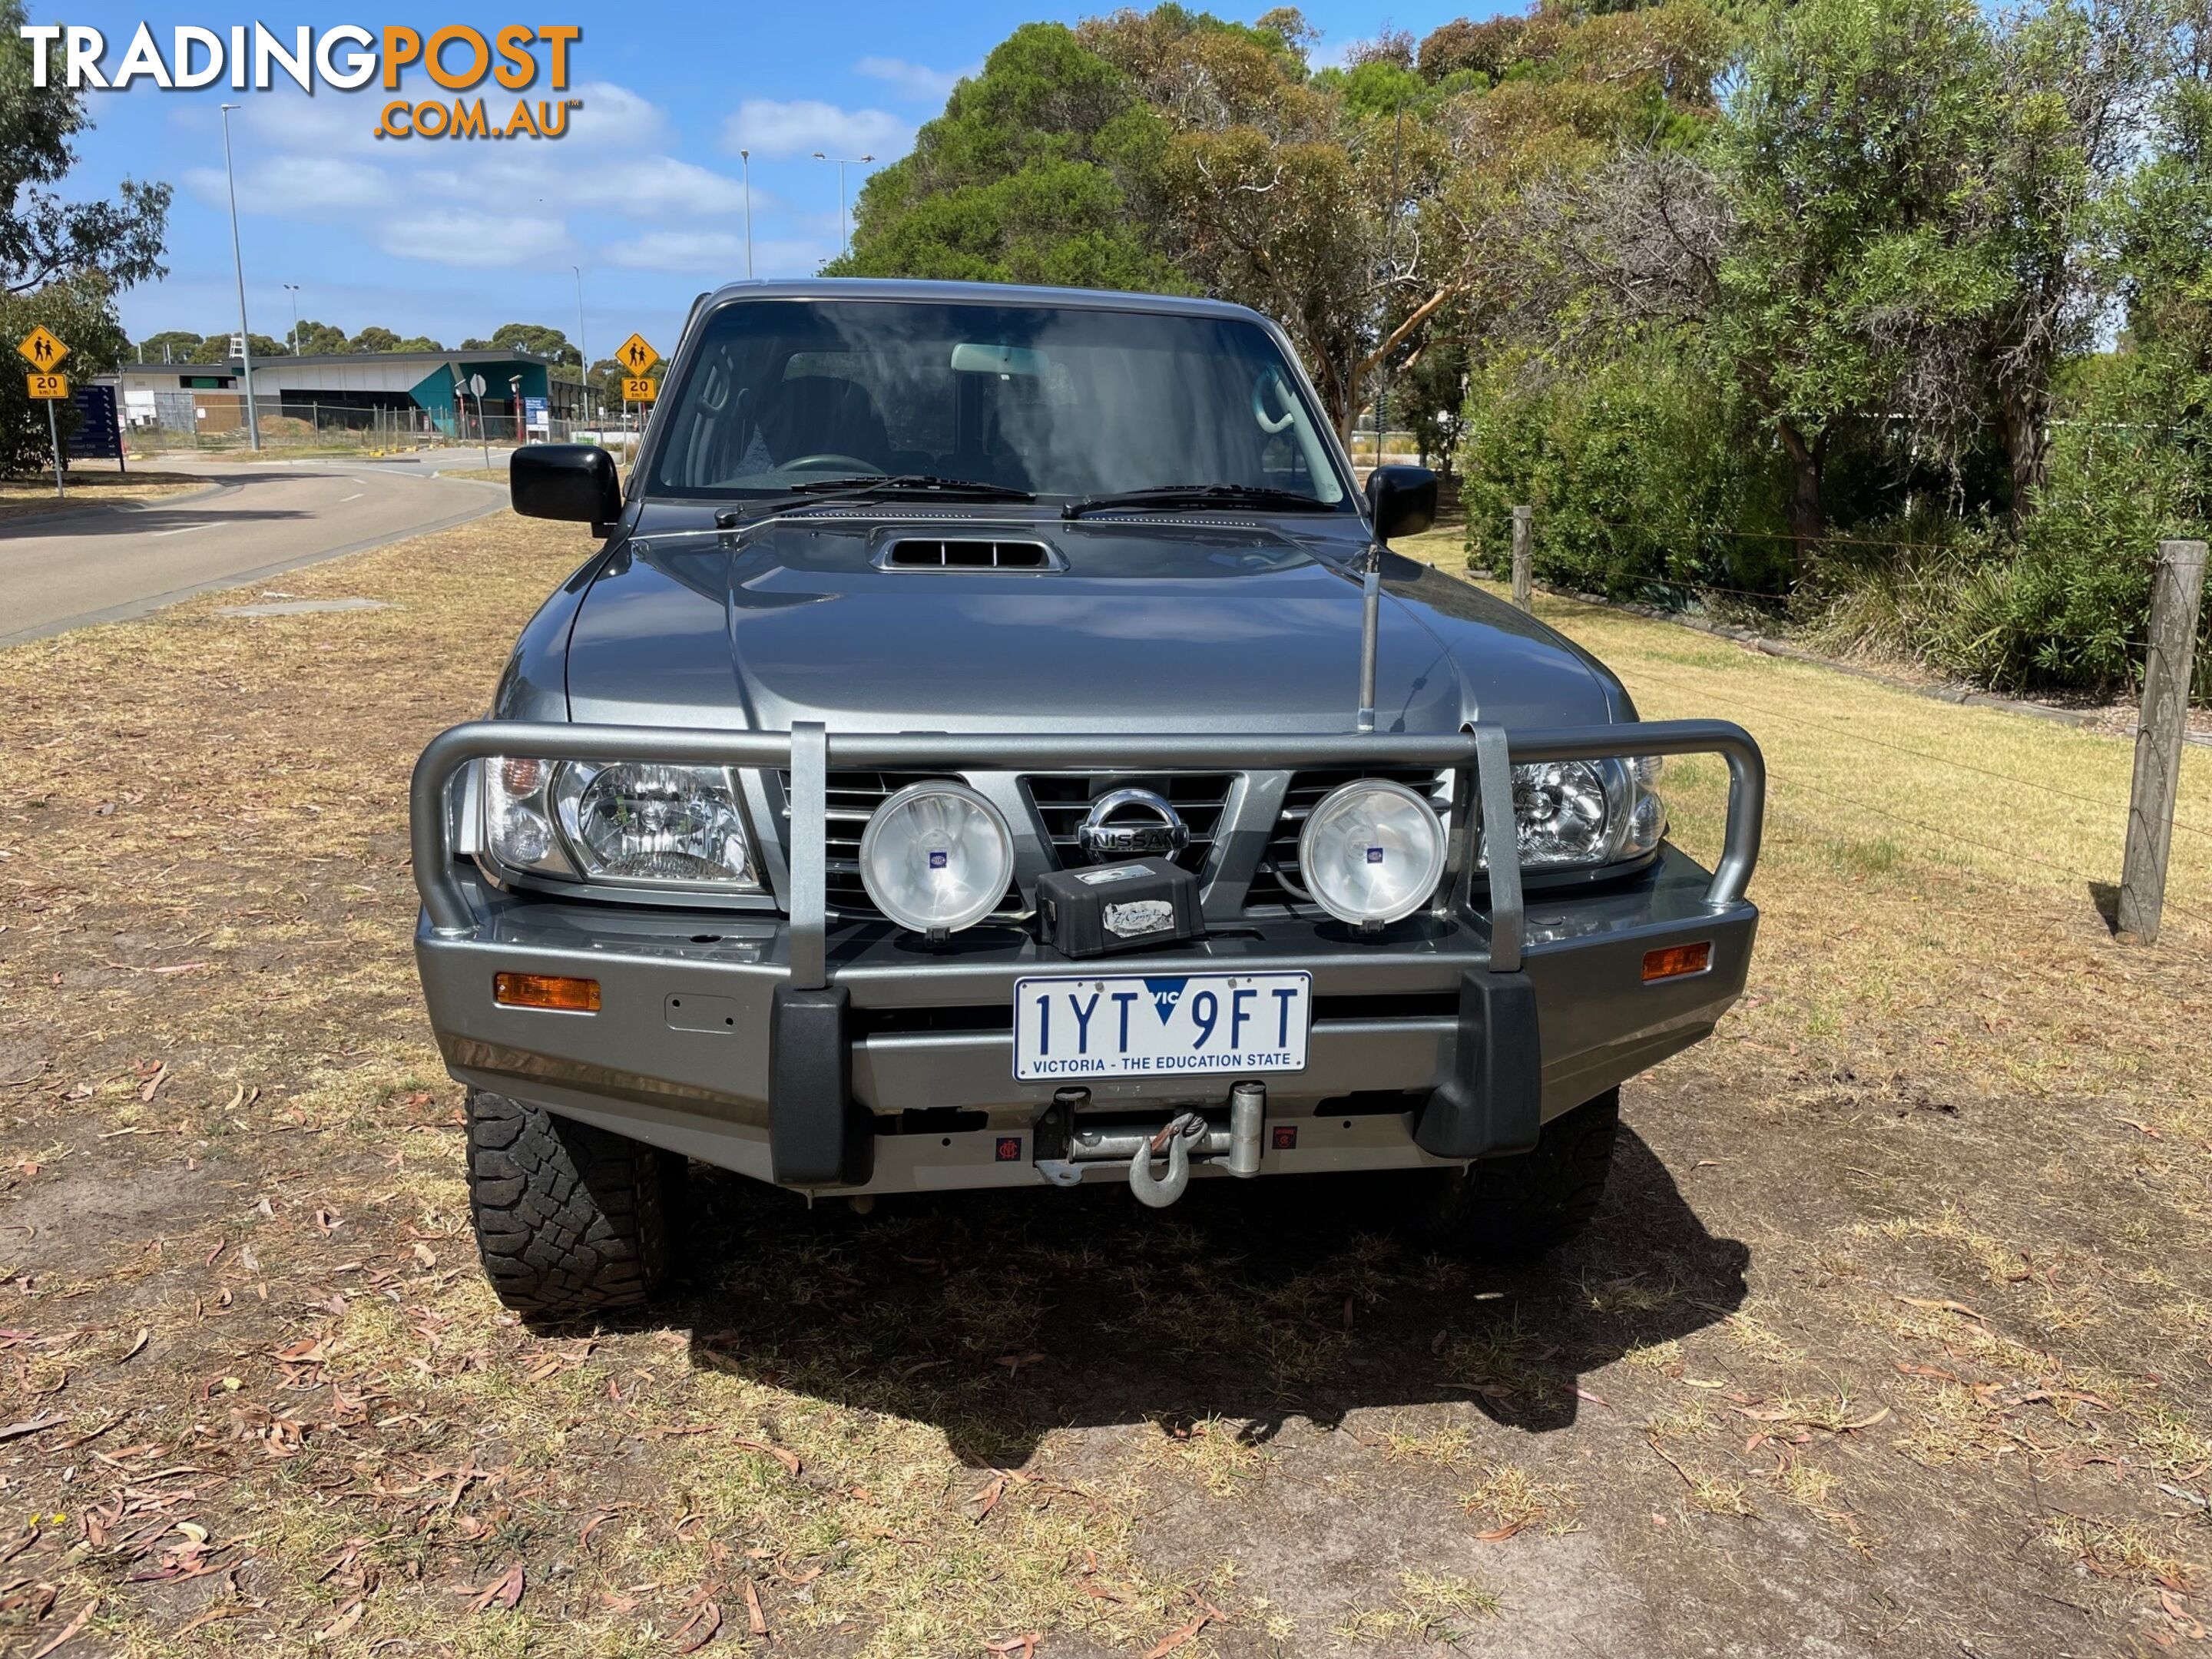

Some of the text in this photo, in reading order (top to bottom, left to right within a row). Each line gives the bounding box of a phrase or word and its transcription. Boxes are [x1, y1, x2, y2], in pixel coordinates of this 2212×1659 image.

[37, 377, 58, 389] 20
[630, 381, 648, 392] 20
[1093, 833, 1178, 847] NISSAN
[1036, 988, 1298, 1055] 1YT VIC 9FT
[1033, 1060, 1105, 1073] VICTORIA
[1121, 1057, 1151, 1071] THE
[1156, 1055, 1242, 1069] EDUCATION
[1247, 1052, 1291, 1066] STATE
